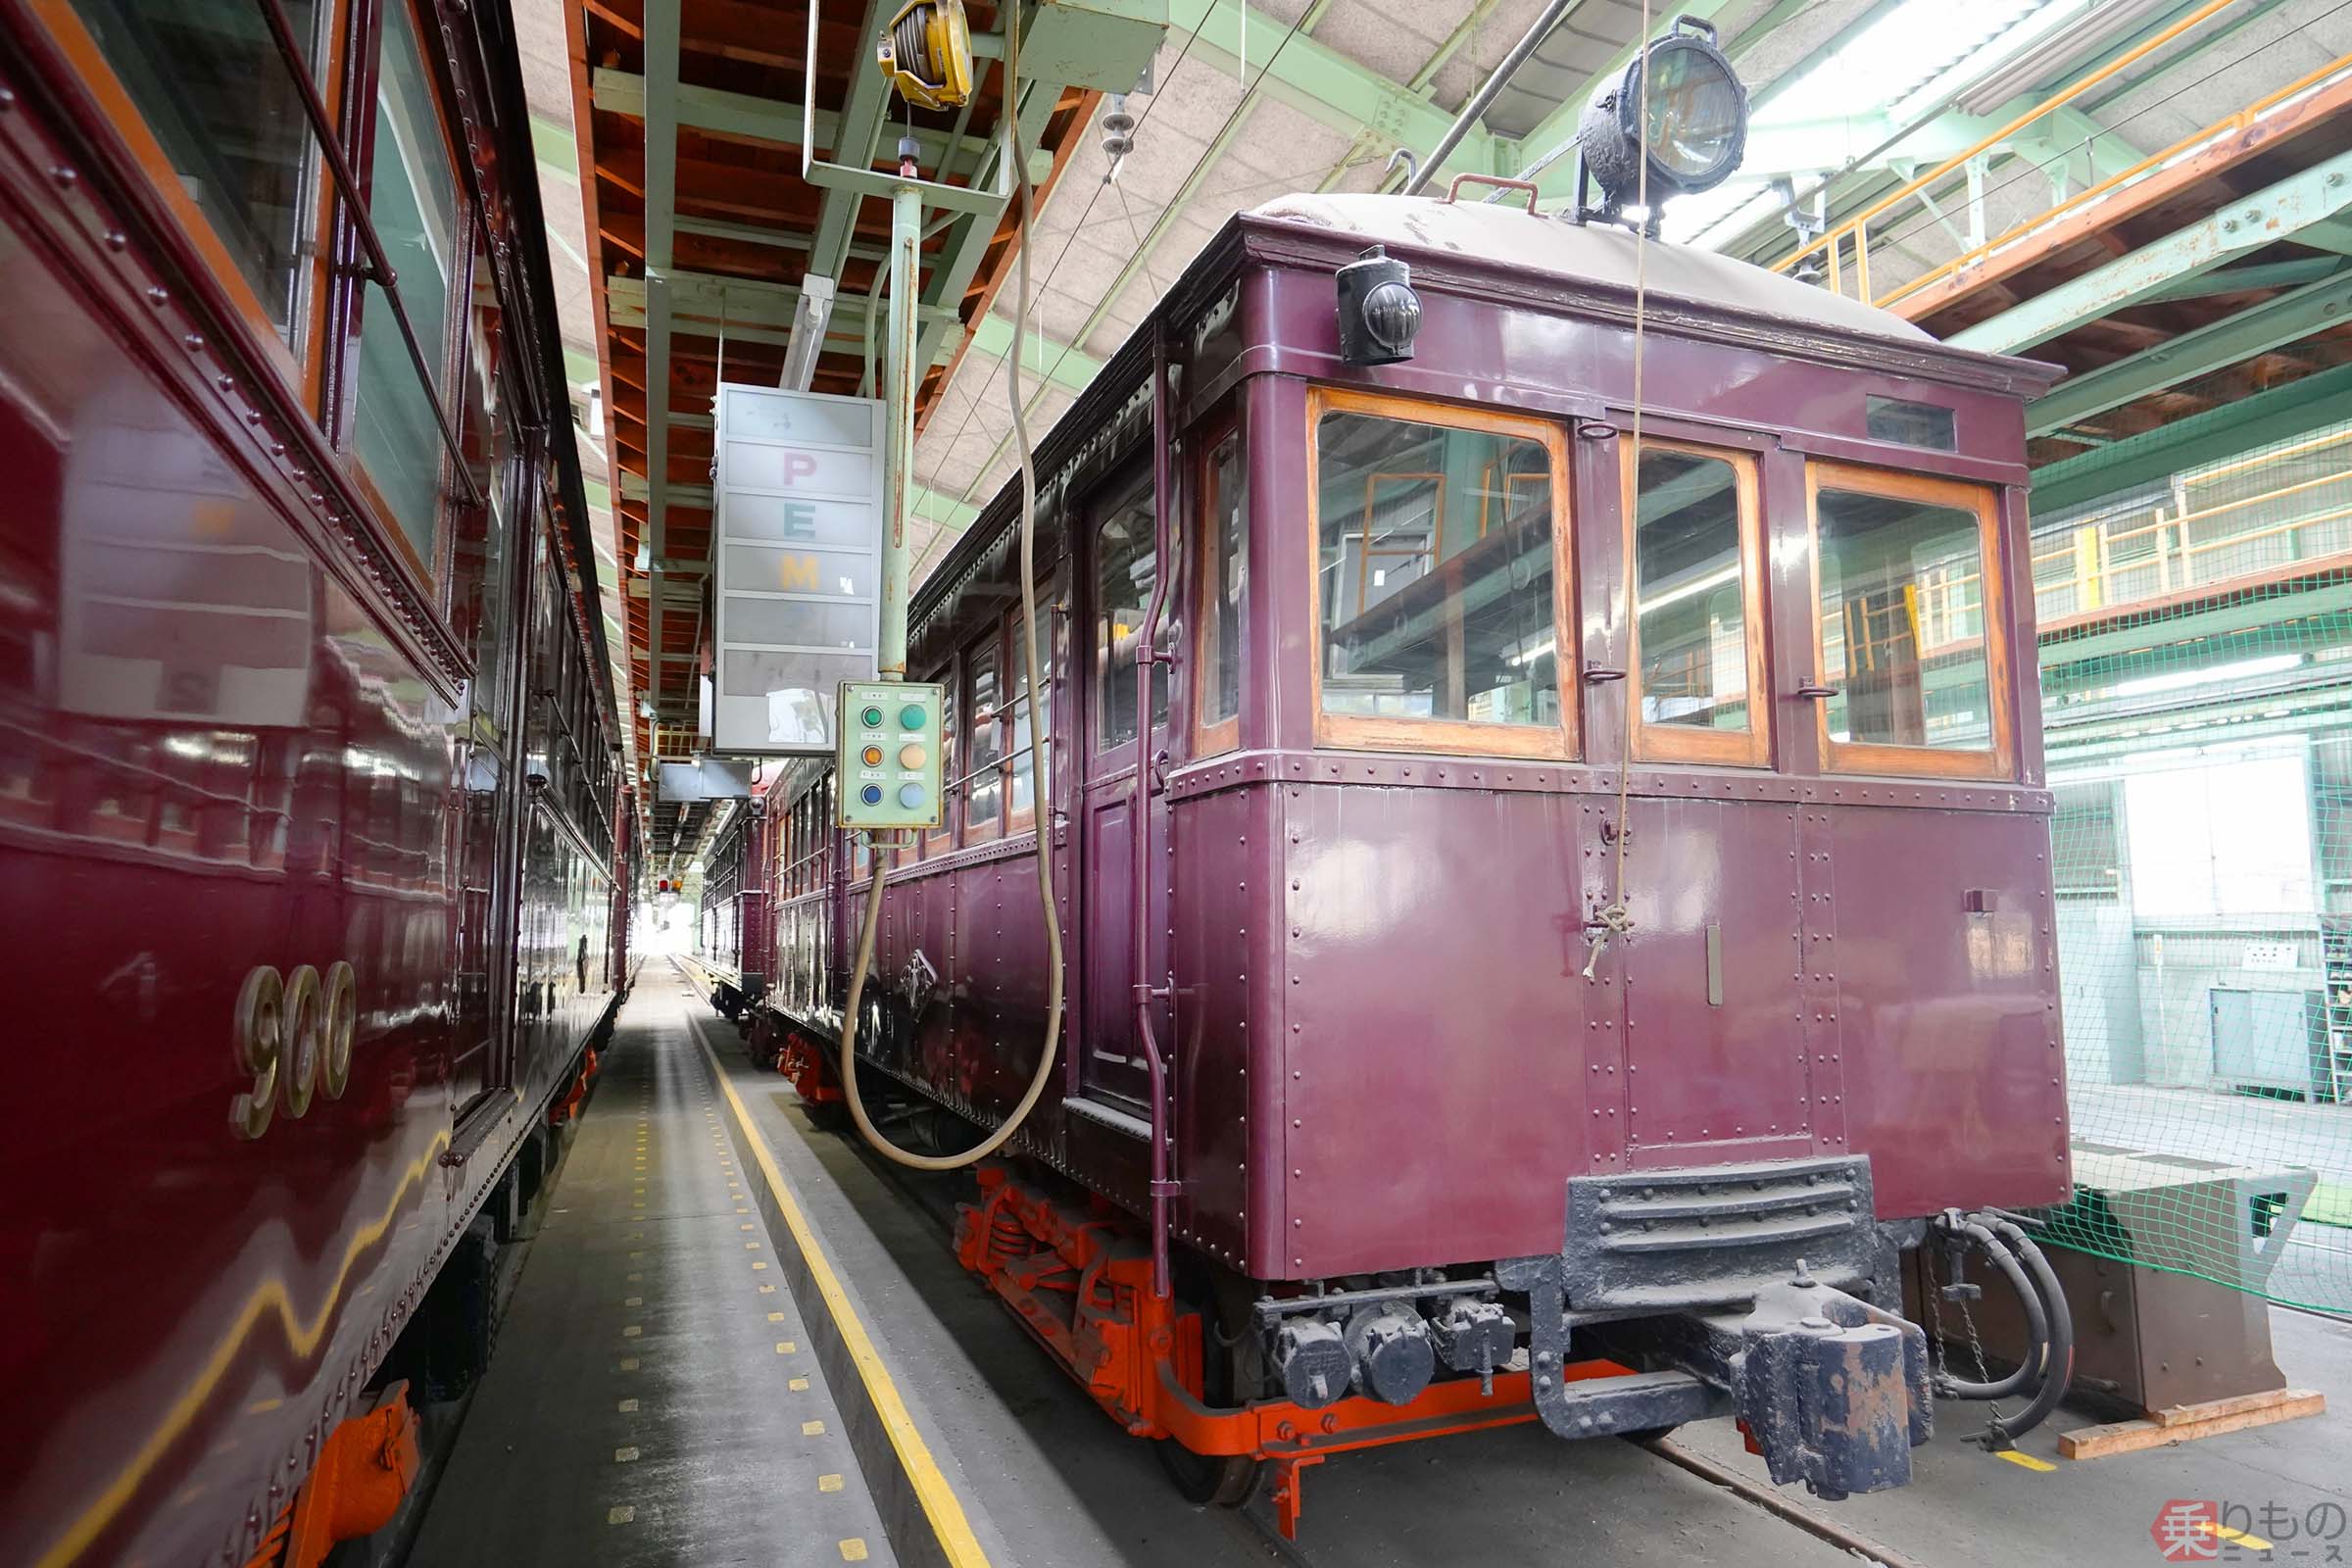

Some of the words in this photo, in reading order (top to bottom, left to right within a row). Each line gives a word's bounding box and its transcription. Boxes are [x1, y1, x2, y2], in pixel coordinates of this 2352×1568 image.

[783, 452, 817, 486] P
[784, 502, 816, 539] E
[779, 552, 819, 591] M
[228, 961, 357, 1140] 900
